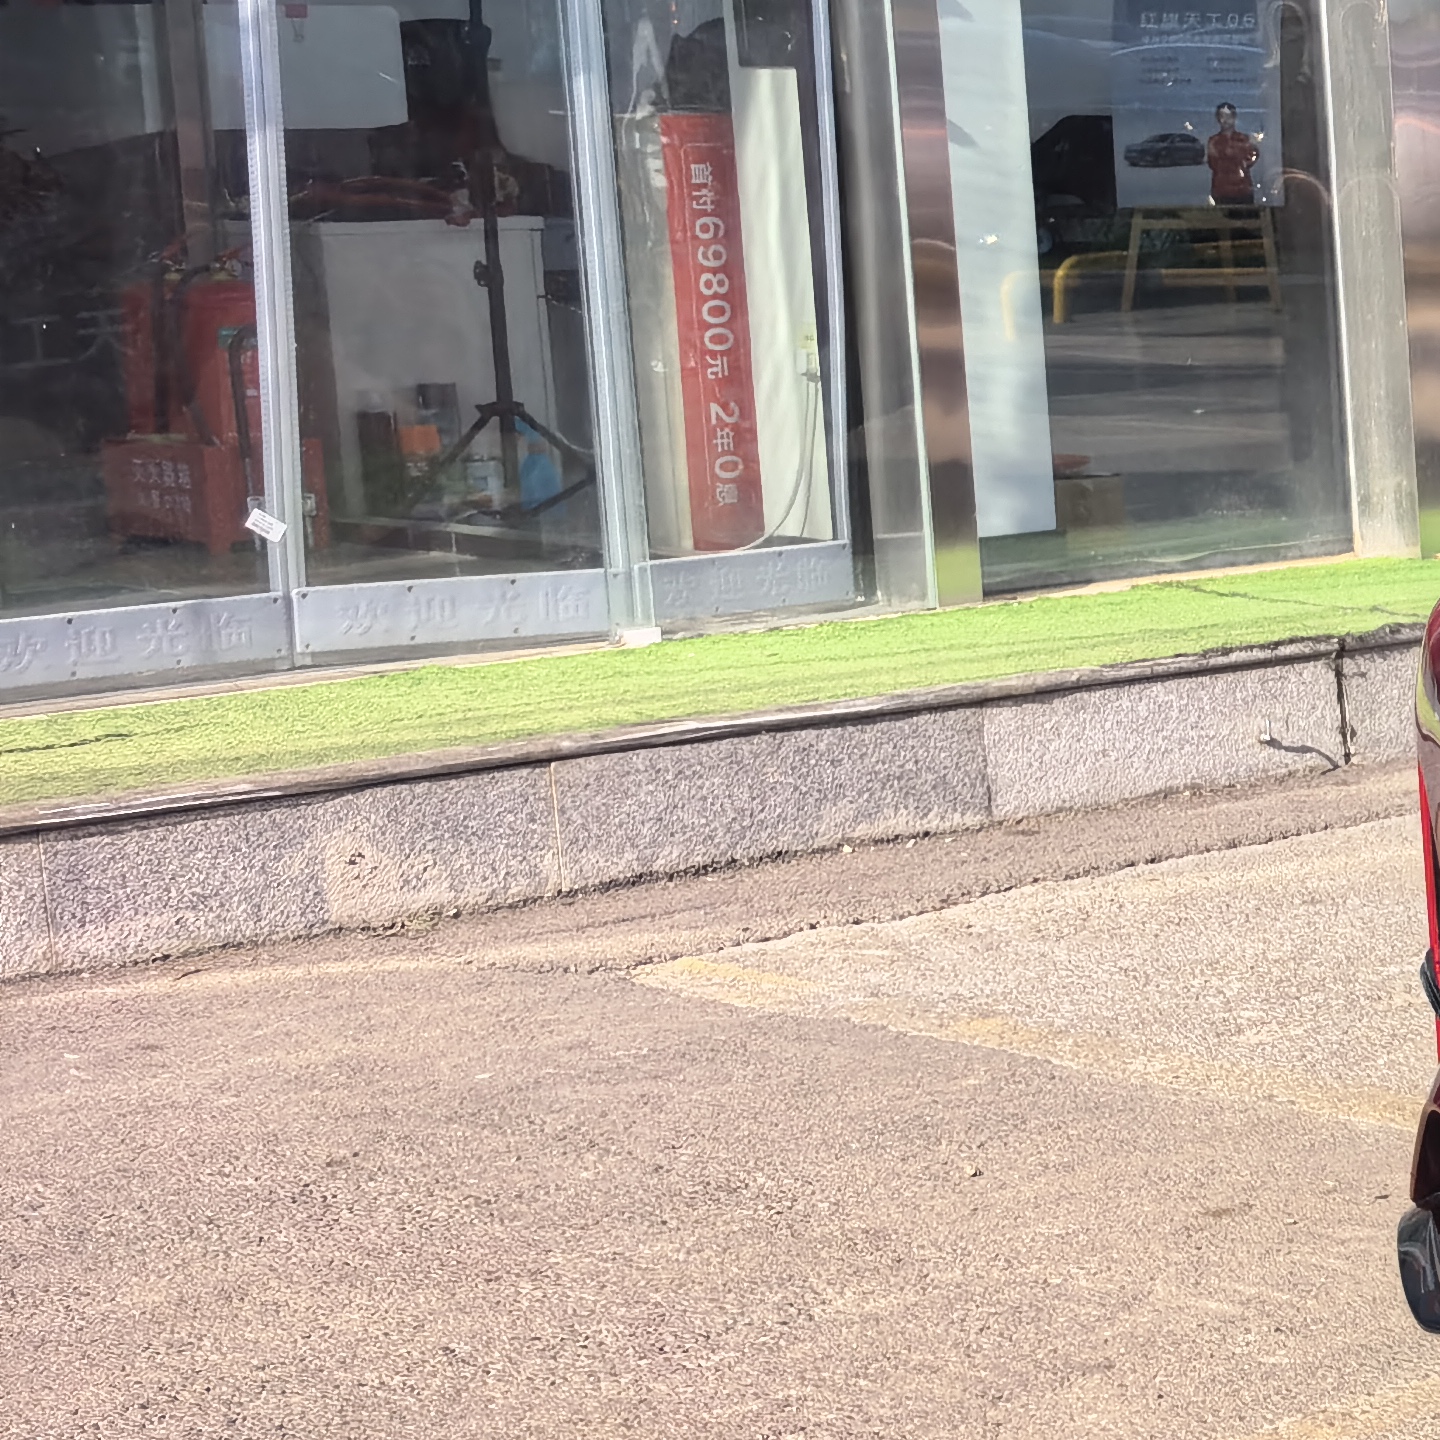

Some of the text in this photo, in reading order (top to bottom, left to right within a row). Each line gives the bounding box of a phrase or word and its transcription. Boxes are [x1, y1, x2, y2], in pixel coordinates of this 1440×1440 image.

[688, 162, 746, 507] 首付69800元 2年0息
[340, 584, 592, 636] 欢迎光临
[0, 611, 253, 674] 欢迎光临
